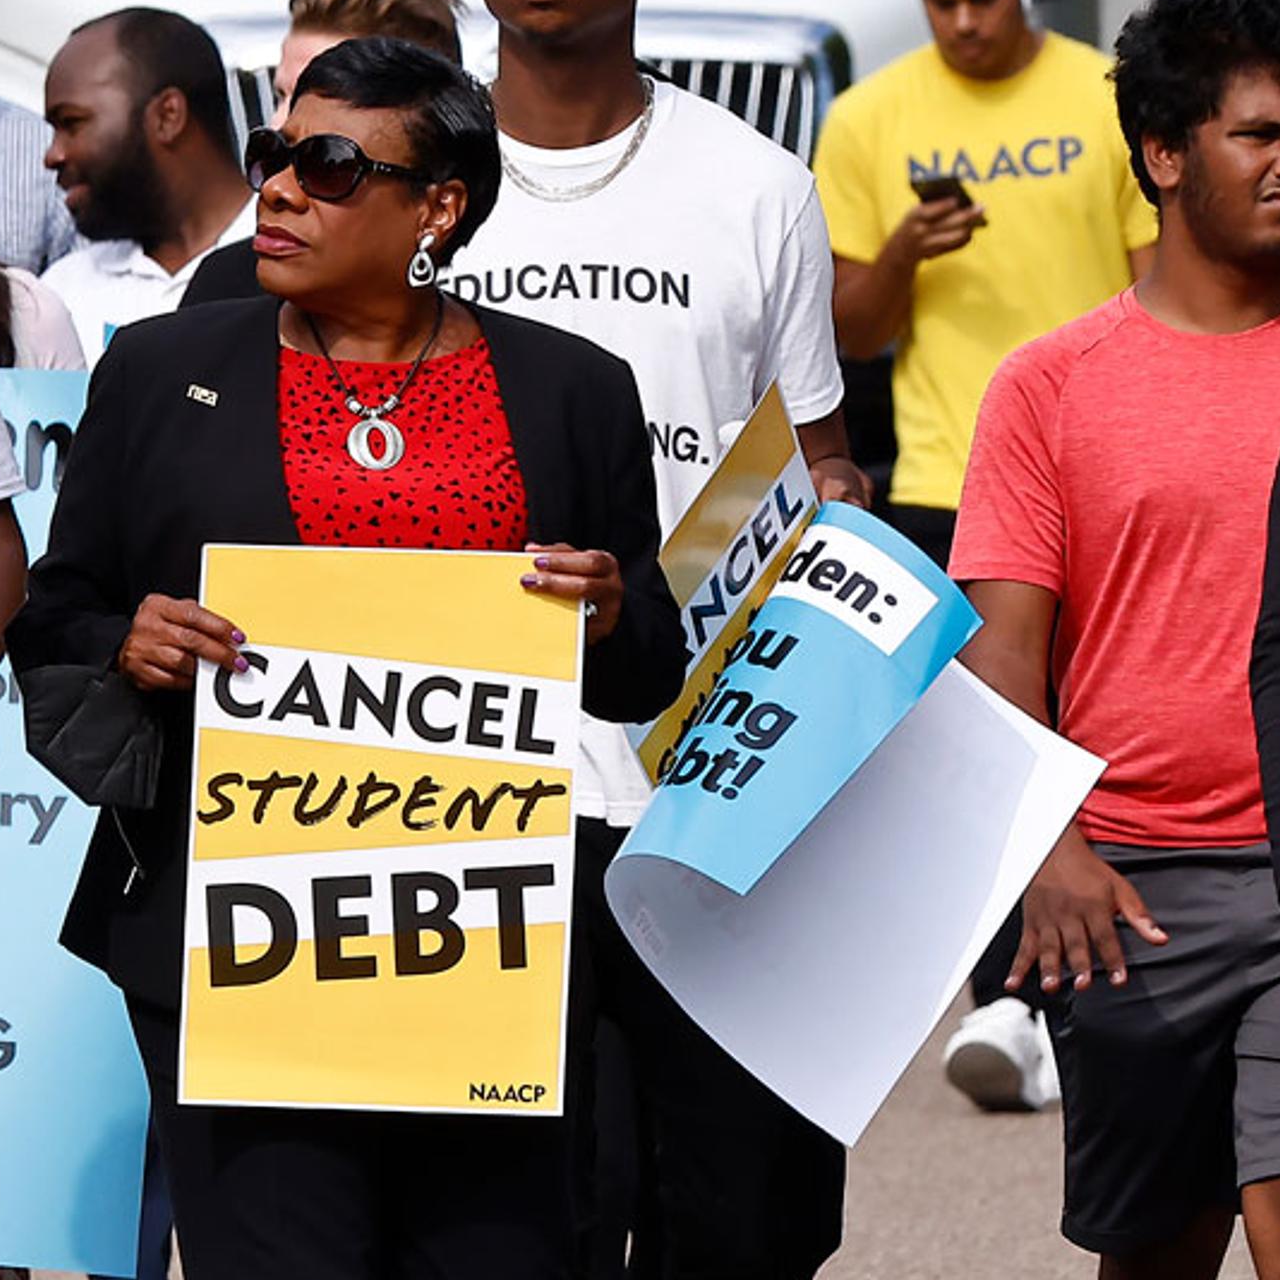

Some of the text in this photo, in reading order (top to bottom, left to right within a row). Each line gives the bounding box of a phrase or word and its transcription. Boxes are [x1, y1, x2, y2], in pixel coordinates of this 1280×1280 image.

[907, 135, 1084, 184] NAACP
[649, 421, 710, 465] NG.
[688, 482, 804, 648] NCEL
[780, 539, 899, 625] den:
[213, 650, 556, 756] CANCEL
[196, 770, 567, 833] STUDENT
[205, 863, 556, 988] DEBT
[469, 1083, 546, 1103] NAACP
